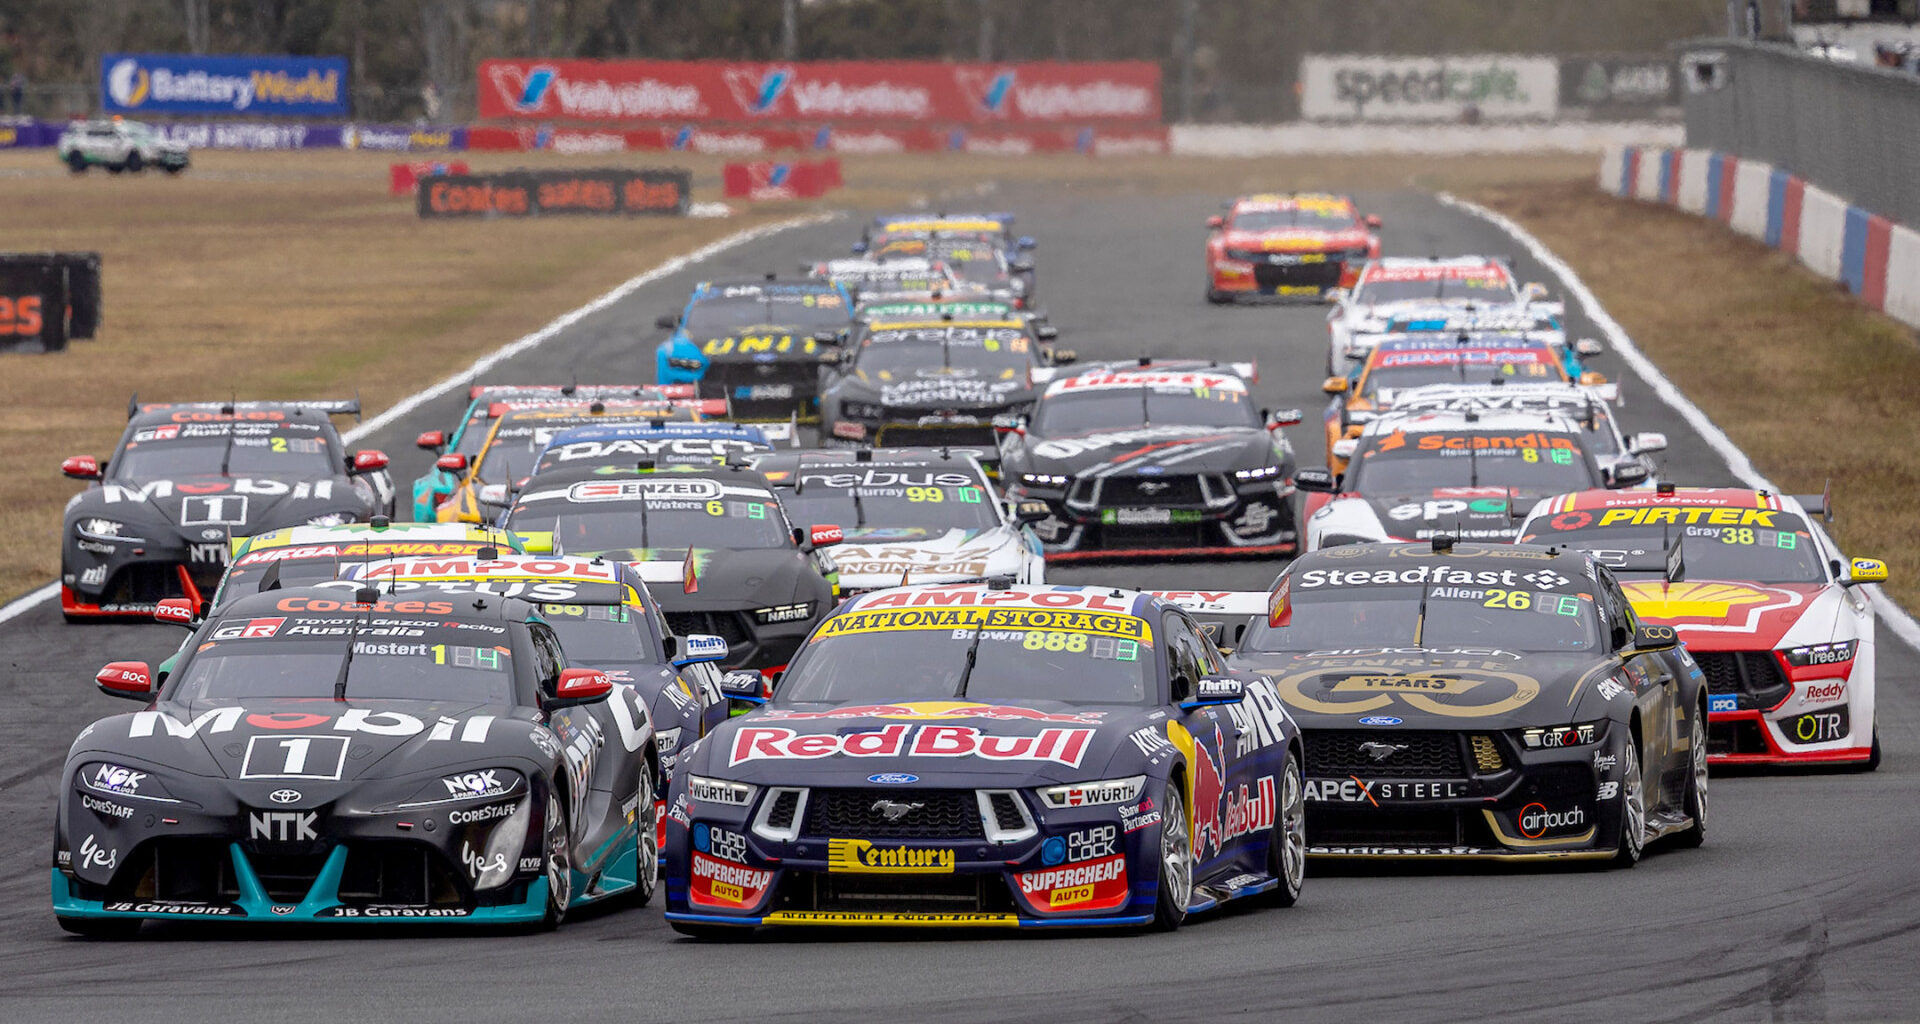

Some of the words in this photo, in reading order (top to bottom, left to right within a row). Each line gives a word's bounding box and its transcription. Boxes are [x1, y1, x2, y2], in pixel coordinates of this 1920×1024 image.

[1062, 373, 1224, 389] Liberty
[270, 436, 289, 453] 2
[1417, 433, 1574, 450] Scandia
[1522, 447, 1539, 464] 8
[103, 478, 334, 504] Mobil
[621, 482, 709, 496] ENZED
[905, 486, 945, 503] 99
[644, 499, 703, 511] Waters
[705, 500, 725, 517] 6
[1597, 506, 1780, 528] PIRTEK
[1686, 525, 1721, 539] Gray
[1721, 528, 1755, 546] 38
[238, 547, 337, 567] MEGA
[361, 559, 610, 580] AMPOL
[1300, 565, 1518, 589] Steadfast
[276, 597, 454, 615] Coates
[860, 589, 1127, 611] AMPOL
[1429, 585, 1484, 600] Allen
[1483, 589, 1532, 610] 26
[766, 607, 810, 623] NARVA
[827, 608, 983, 634] NATIONAL
[989, 610, 1139, 636] STORAGE
[212, 624, 277, 639] GR
[295, 618, 369, 627] TOYOTA
[443, 621, 506, 635] Racing
[285, 624, 426, 637] Australia
[687, 637, 726, 650] Thrifty
[951, 628, 1023, 641] Brown
[1022, 631, 1088, 654] 888
[351, 641, 428, 657] Mostert
[430, 643, 446, 665] 1
[121, 670, 148, 684] BOC
[1198, 678, 1243, 694] Thrifty
[1806, 682, 1847, 701] Reddy
[1712, 699, 1737, 711] PPQ
[128, 706, 497, 744] Mobil
[1797, 712, 1842, 741] OTR
[728, 723, 912, 768] Red
[908, 724, 1097, 769] Bull
[1542, 727, 1595, 748] GROVE
[278, 738, 312, 774] 1
[94, 763, 147, 789] NGK
[441, 768, 502, 794] NGK
[692, 783, 737, 803] WÜRTH
[1085, 786, 1136, 804] WÜRTH
[1303, 777, 1378, 805] APEX
[1381, 783, 1458, 799] STEEL
[249, 810, 319, 842] NTK
[1521, 804, 1585, 829] airtouch
[709, 825, 747, 851] QUAD
[1068, 824, 1116, 848] QUAD
[710, 840, 748, 865] LOCK
[1067, 838, 1116, 862] LOCK
[692, 854, 771, 893] SUPERCHEAP
[1021, 857, 1126, 894] SUPERCHEAP
[713, 884, 740, 900] AUTO
[1054, 888, 1091, 904] AUTO
[106, 902, 132, 912] JB
[134, 903, 233, 916] Caravans
[334, 906, 360, 918] JB
[364, 906, 468, 917] Caravans
